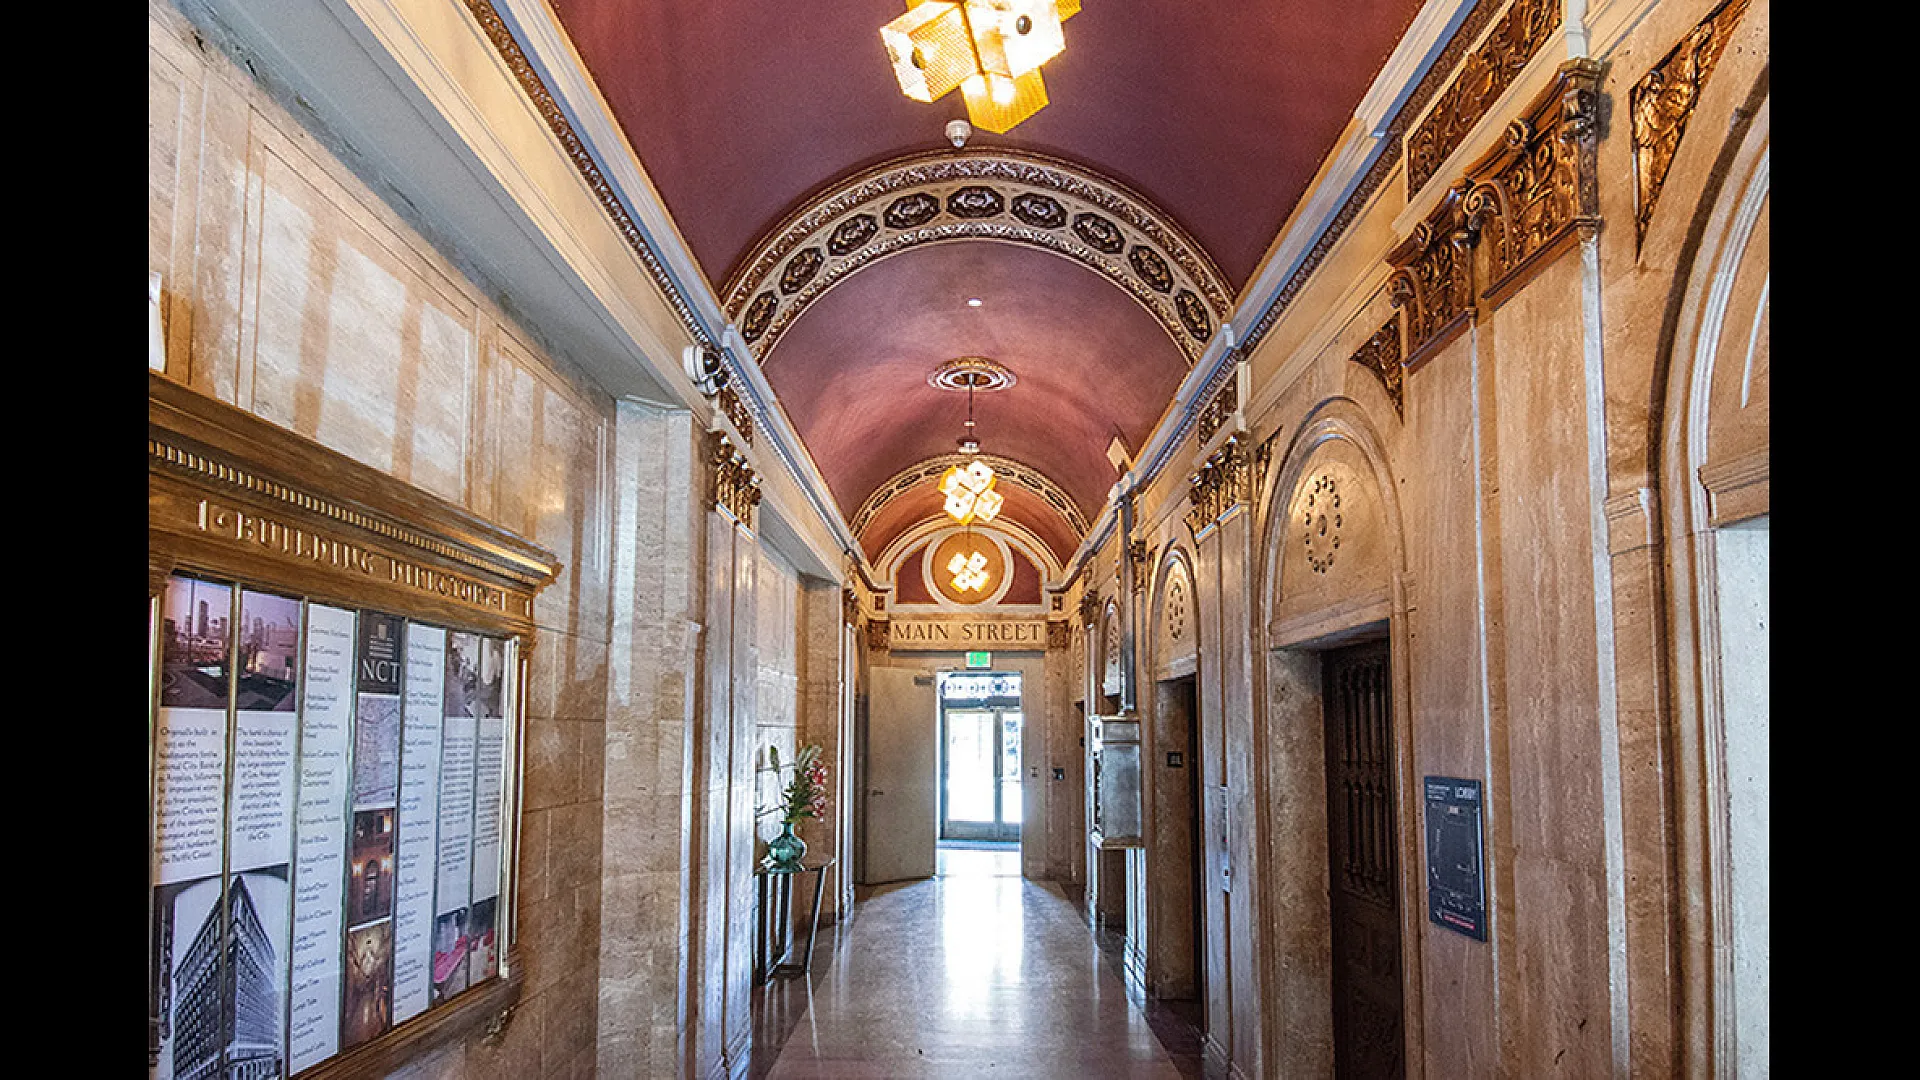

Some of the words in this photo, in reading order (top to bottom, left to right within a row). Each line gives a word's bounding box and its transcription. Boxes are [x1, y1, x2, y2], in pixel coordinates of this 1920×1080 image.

[236, 511, 375, 574] BUILDING
[388, 558, 493, 606] DIRECTORY
[893, 622, 949, 641] MAIN
[962, 622, 1042, 641] STREET
[362, 658, 400, 683] NCT
